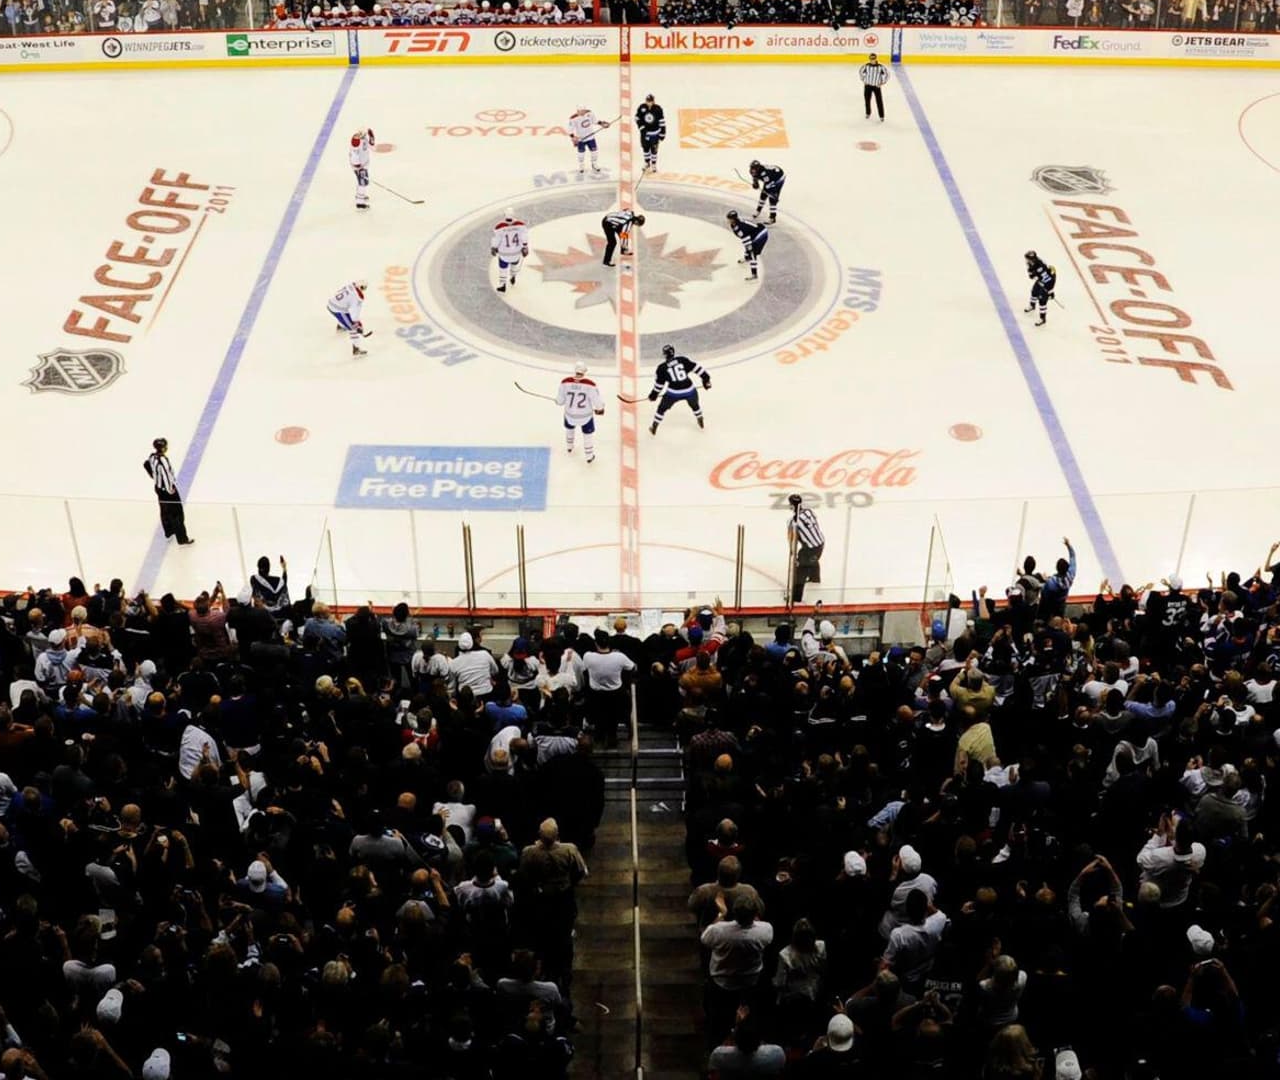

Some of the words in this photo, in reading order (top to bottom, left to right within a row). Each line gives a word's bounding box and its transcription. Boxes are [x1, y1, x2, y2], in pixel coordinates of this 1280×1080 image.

[54, 39, 75, 48] Life
[384, 31, 471, 53] TSN
[520, 33, 607, 49] ticketexchange
[645, 31, 686, 49] bulk
[693, 31, 740, 49] barn
[766, 34, 860, 48] aircanada.com
[1053, 35, 1100, 50] FedEx
[1184, 36, 1212, 46] JETS
[1214, 37, 1245, 47] GEAR
[426, 125, 569, 137] TOYOTA
[205, 185, 236, 214] 2011
[504, 233, 520, 248] 14
[63, 168, 210, 343] FACE-OFF
[378, 265, 421, 324] centre
[842, 266, 883, 313] MTS
[1051, 200, 1235, 391] FACE-OFF
[395, 323, 479, 367] MTS
[774, 308, 860, 366] centre
[1089, 324, 1133, 364] 2011
[667, 363, 687, 382] 16
[567, 392, 587, 409] 72
[374, 455, 523, 479] Winnipeg
[708, 447, 923, 491] Coca-Cola
[359, 478, 427, 498] Free
[431, 479, 524, 499] Press
[768, 490, 874, 511] zero
